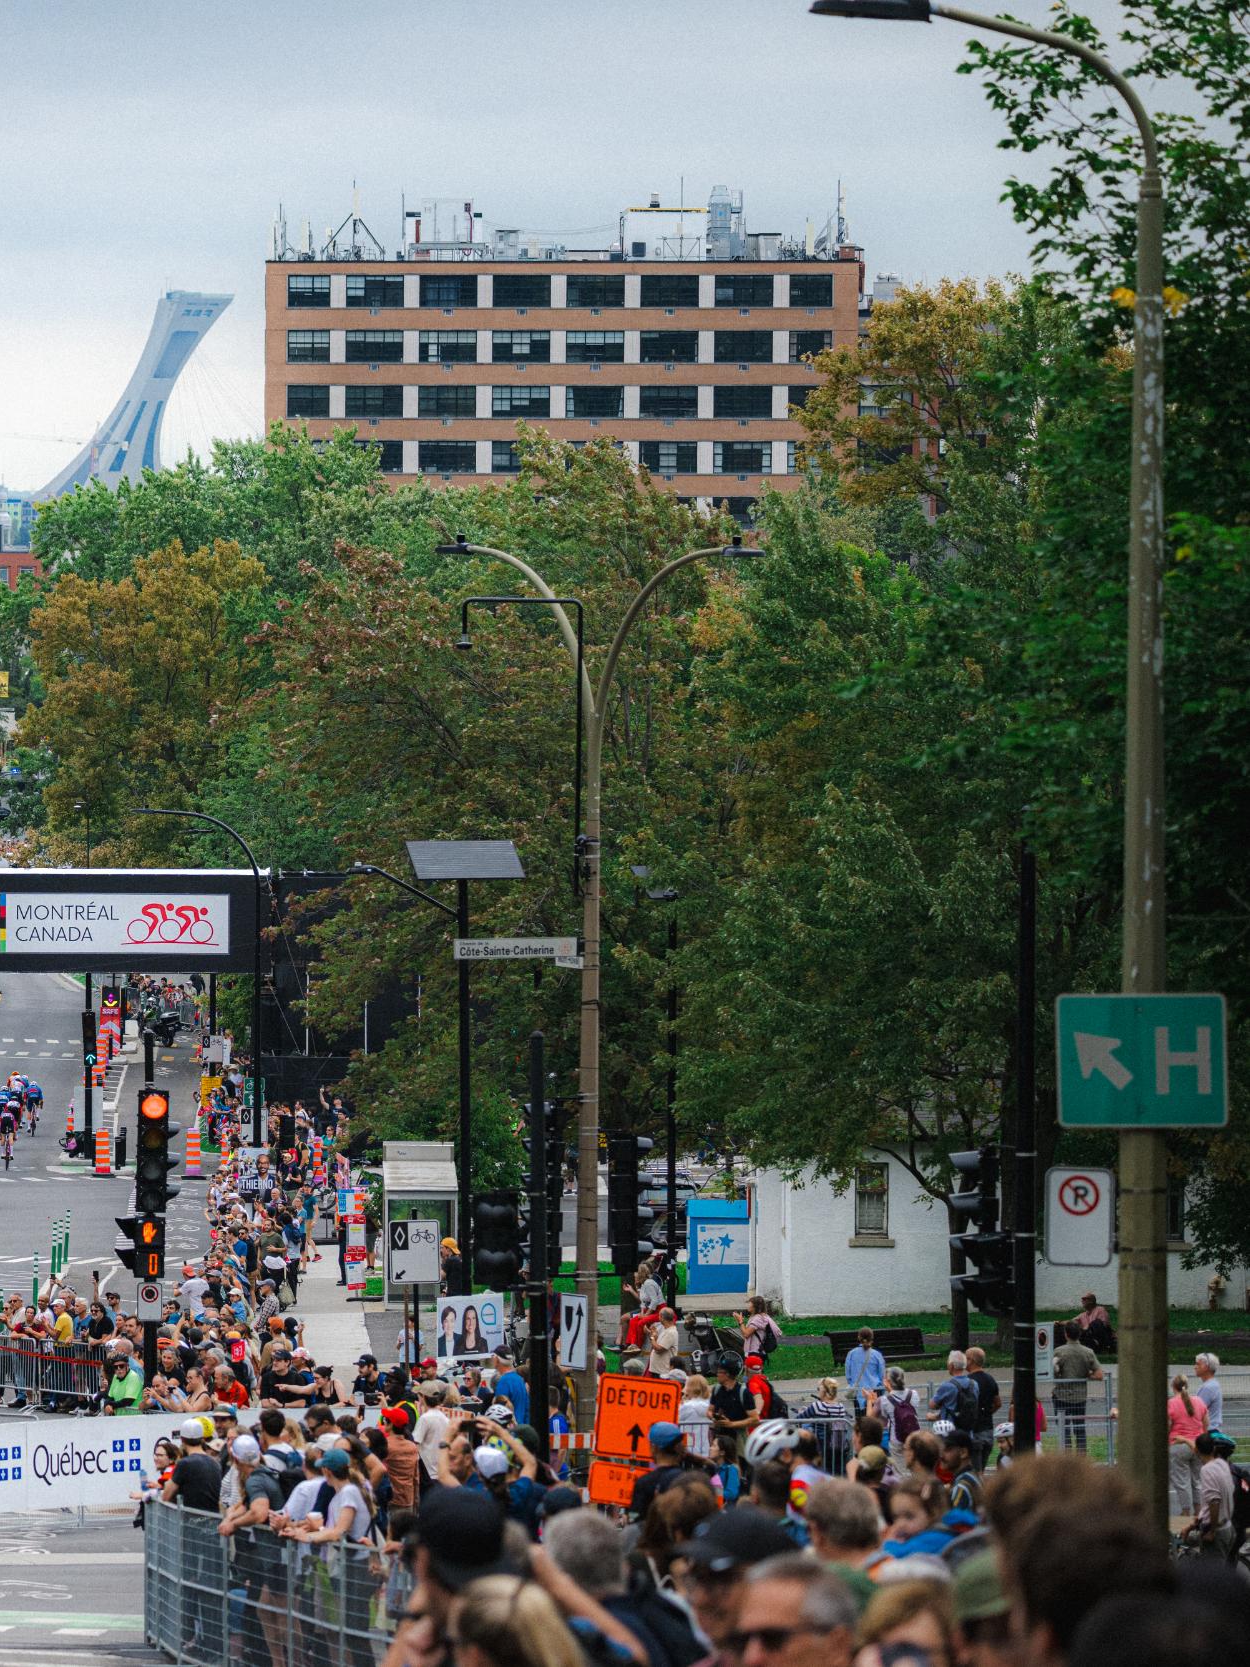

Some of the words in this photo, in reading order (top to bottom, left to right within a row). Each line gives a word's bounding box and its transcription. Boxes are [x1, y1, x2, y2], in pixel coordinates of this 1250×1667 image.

[16, 902, 119, 921] MONTRÉAL
[15, 926, 93, 942] CANADA
[460, 945, 554, 957] Côte-Sainte-Catherine
[1155, 1026, 1211, 1095] H
[241, 1179, 273, 1190] THIERNO
[1073, 1185, 1089, 1206] P
[149, 1254, 158, 1275] 0
[606, 1384, 672, 1409] DÉTOUR
[33, 1442, 108, 1486] Québec
